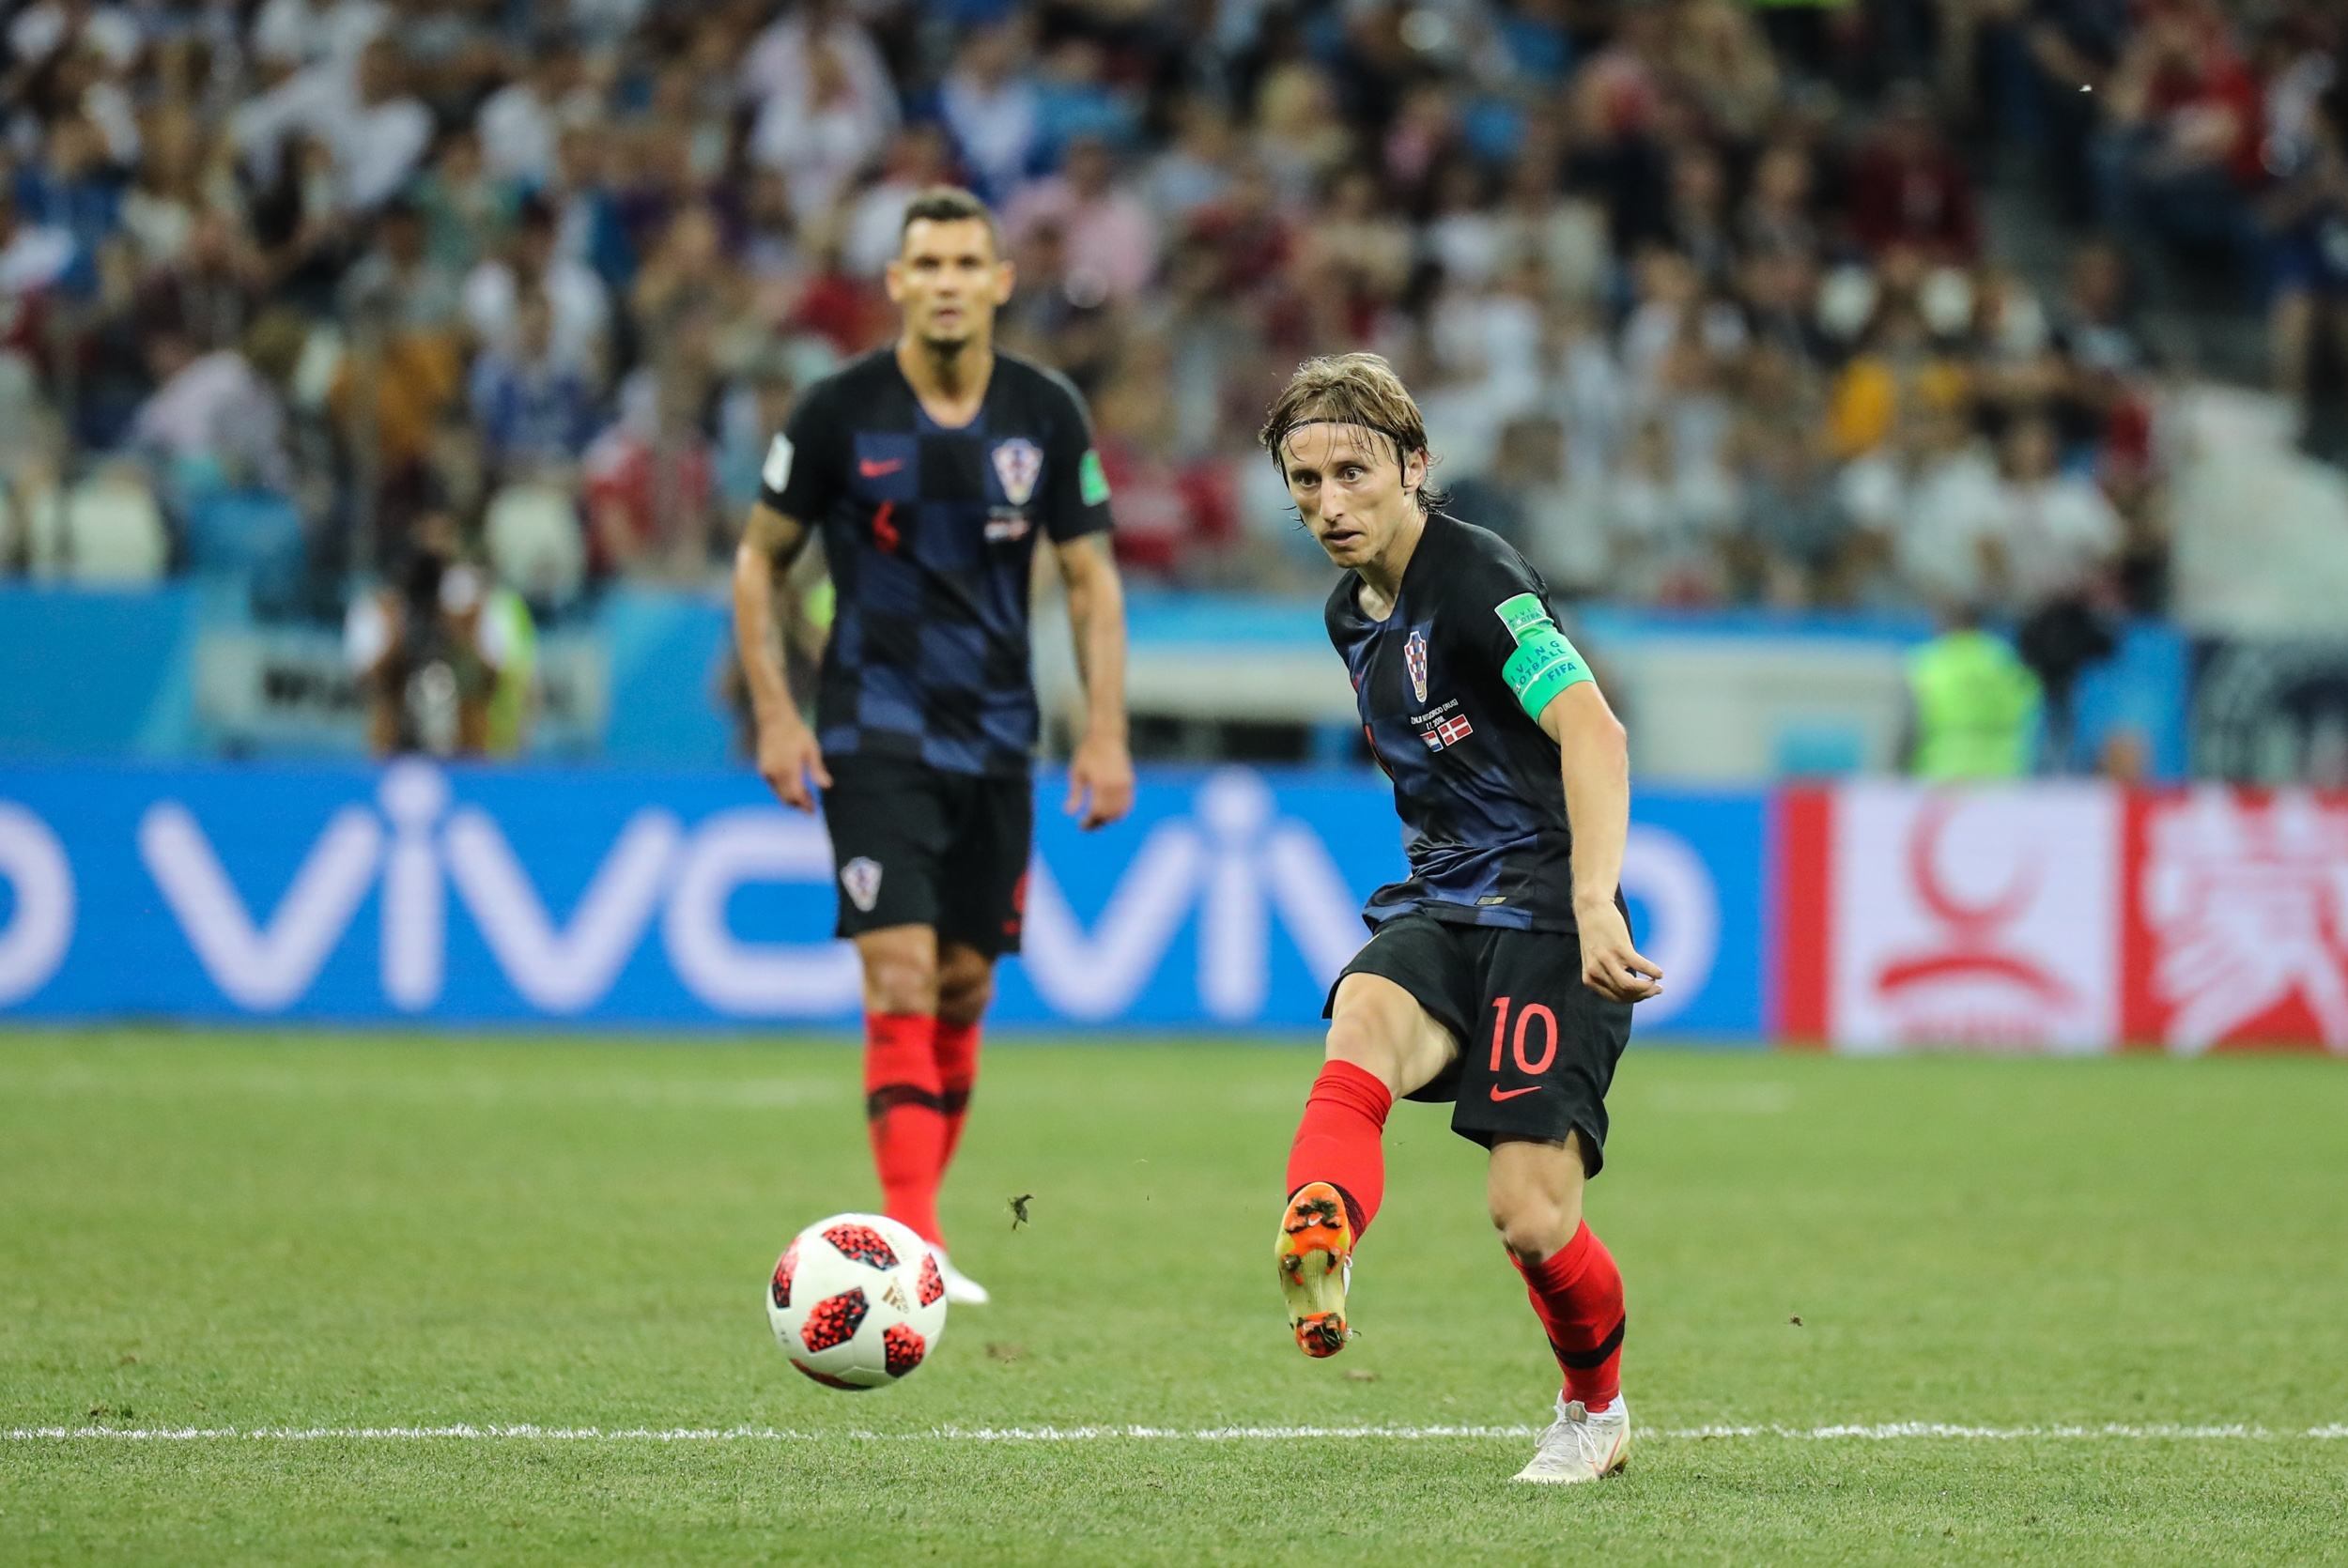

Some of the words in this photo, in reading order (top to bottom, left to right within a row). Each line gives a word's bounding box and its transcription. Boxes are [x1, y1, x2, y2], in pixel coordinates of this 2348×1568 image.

[872, 500, 901, 554] 6
[1510, 640, 1560, 683] IVING
[1547, 662, 1577, 682] FIFA
[1490, 996, 1559, 1075] 10
